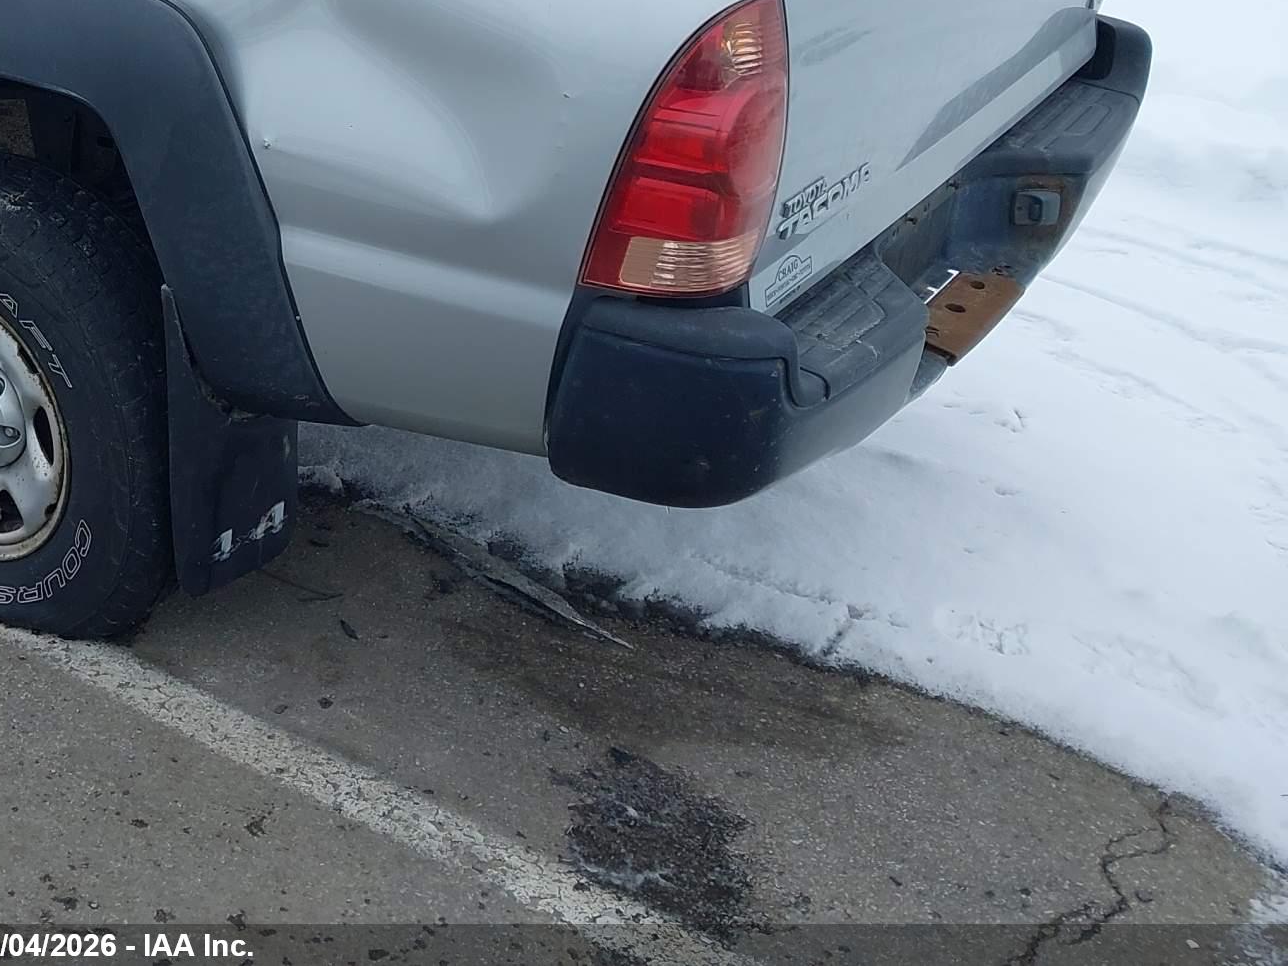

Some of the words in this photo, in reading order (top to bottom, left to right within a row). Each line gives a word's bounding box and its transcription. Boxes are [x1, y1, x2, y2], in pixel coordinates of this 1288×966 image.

[776, 162, 873, 241] TACOMA
[782, 176, 830, 219] TOYOTA
[777, 259, 800, 282] CRAIG
